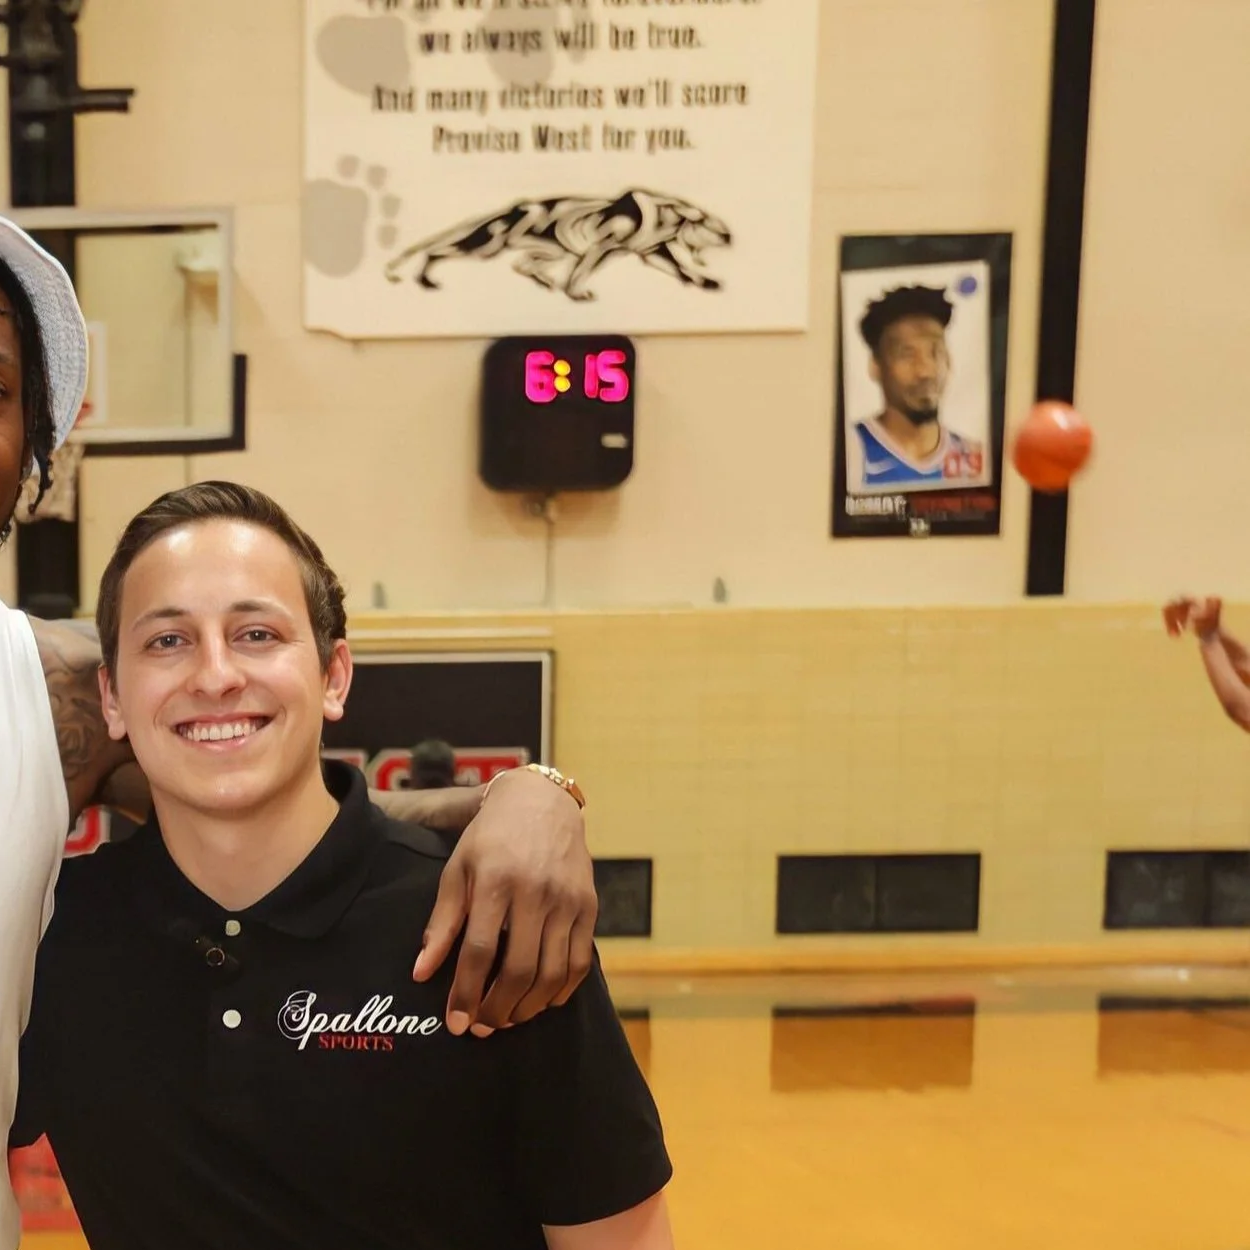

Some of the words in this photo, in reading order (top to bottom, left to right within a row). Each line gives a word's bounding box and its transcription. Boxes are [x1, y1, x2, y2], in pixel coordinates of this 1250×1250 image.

[419, 31, 450, 54] we
[461, 27, 542, 56] always
[554, 22, 595, 50] will
[609, 21, 635, 50] be
[372, 84, 415, 113] And
[426, 88, 488, 116] many
[499, 82, 604, 109] victories
[682, 83, 748, 107] score
[532, 123, 591, 151] West
[602, 121, 636, 150] for
[277, 990, 442, 1050] Spallone
[318, 1036, 394, 1050] SPORTS
